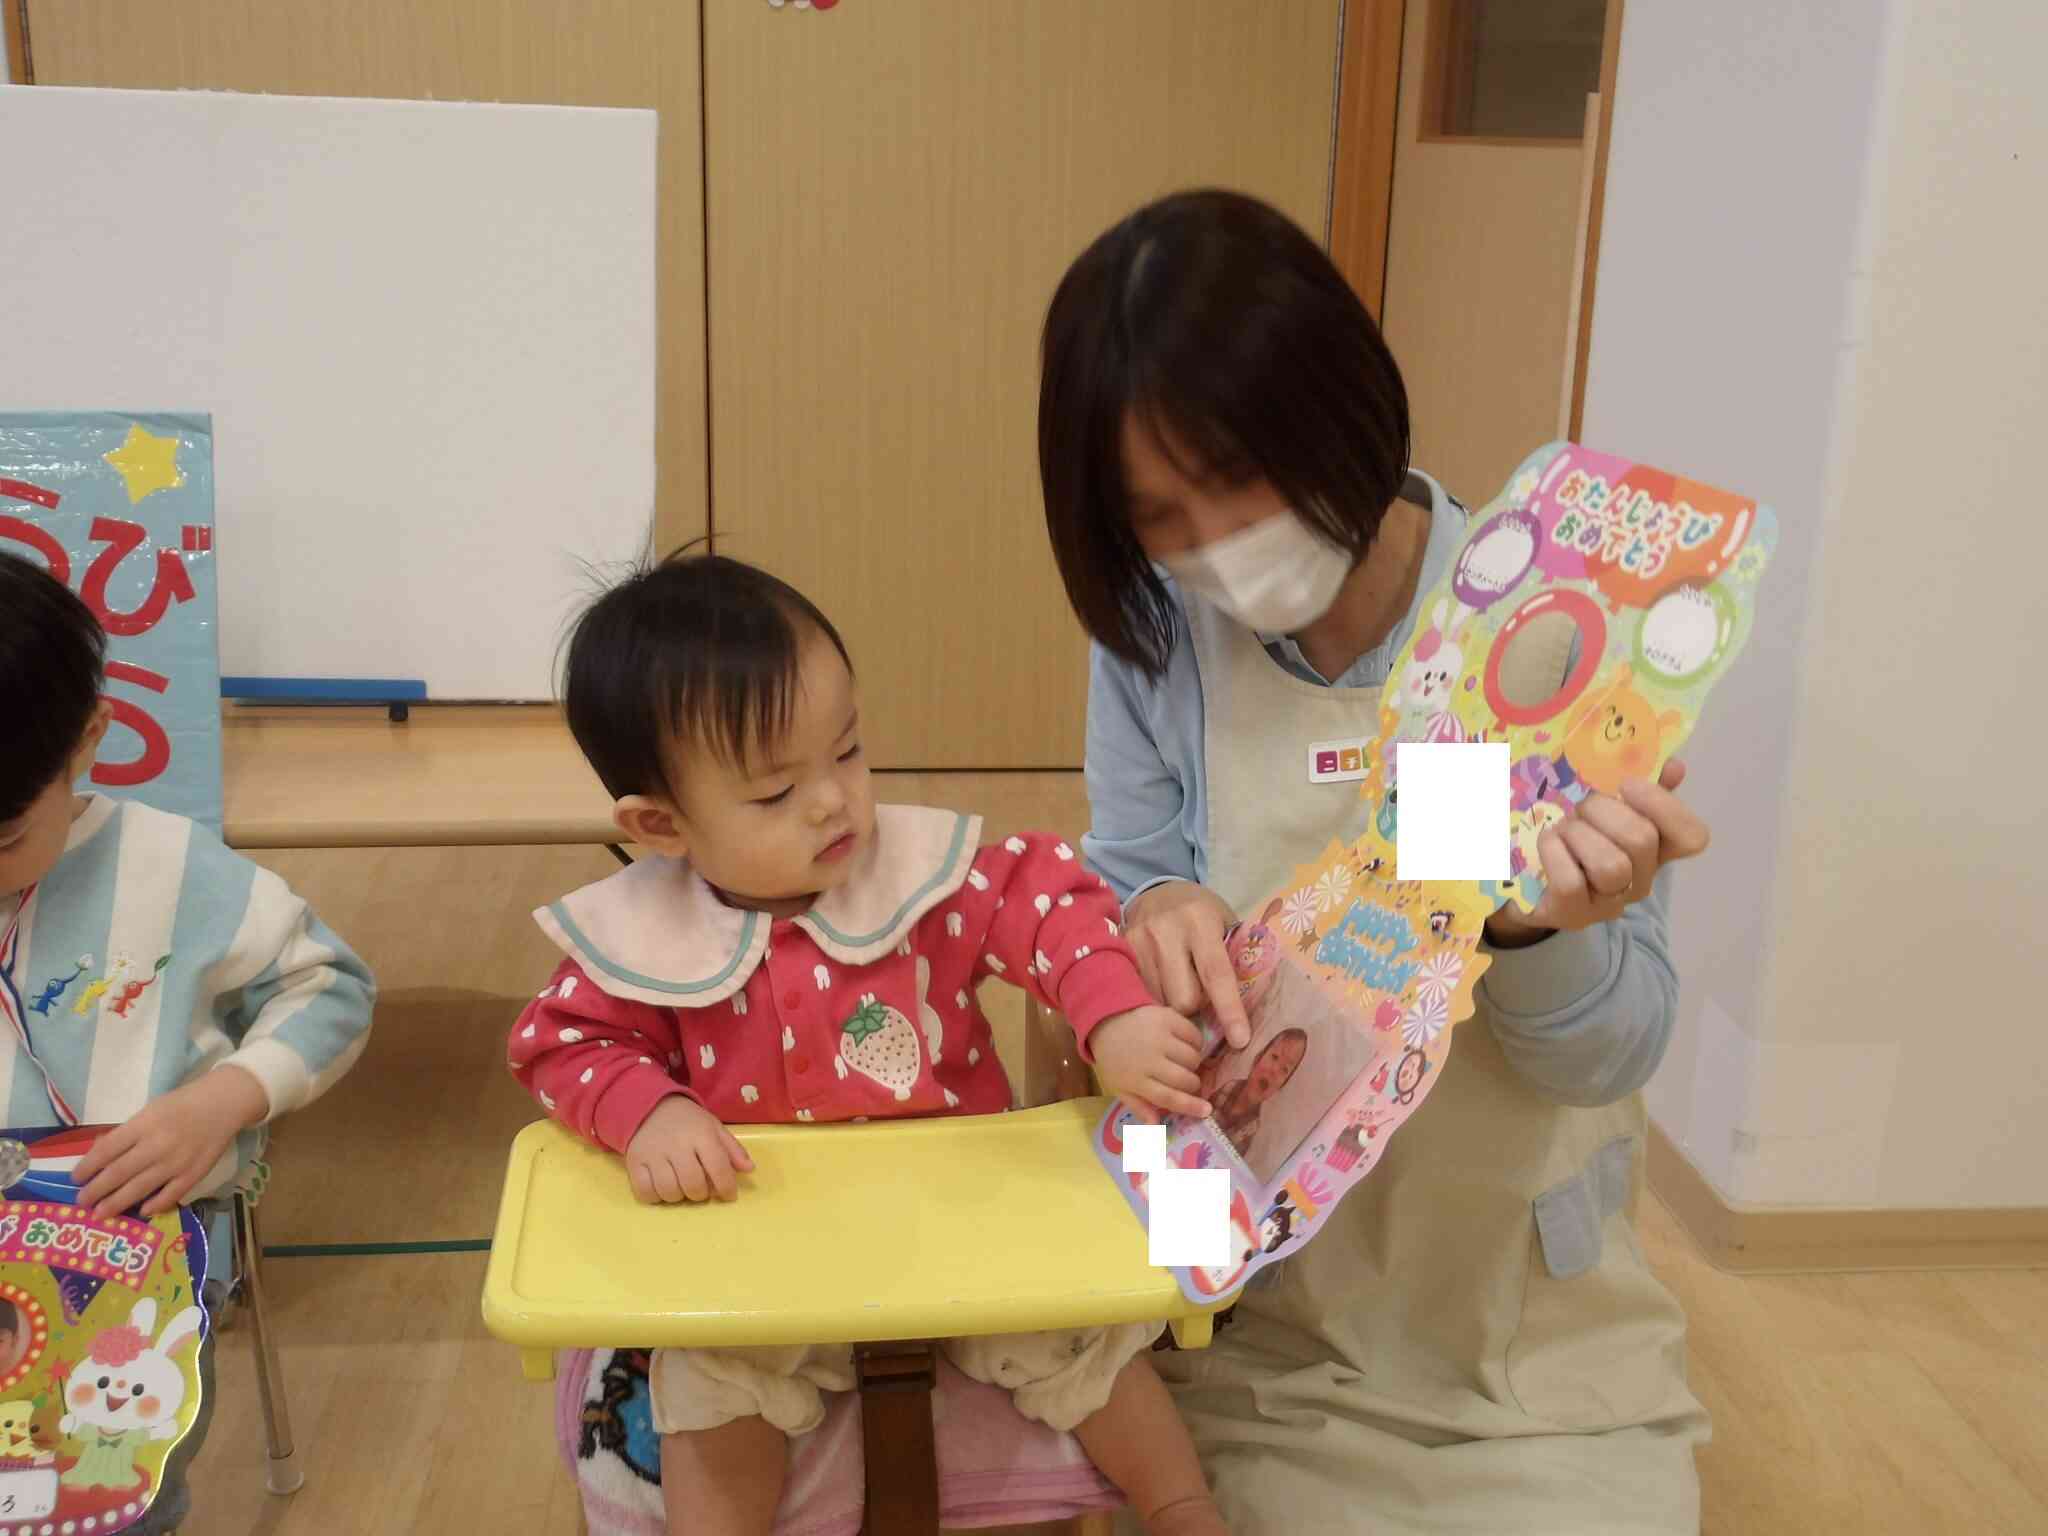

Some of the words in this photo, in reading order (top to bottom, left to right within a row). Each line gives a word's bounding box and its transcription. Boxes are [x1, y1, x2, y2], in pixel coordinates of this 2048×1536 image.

[1552, 508, 1672, 580] おめでとう
[22, 1218, 152, 1272] おめでとう
